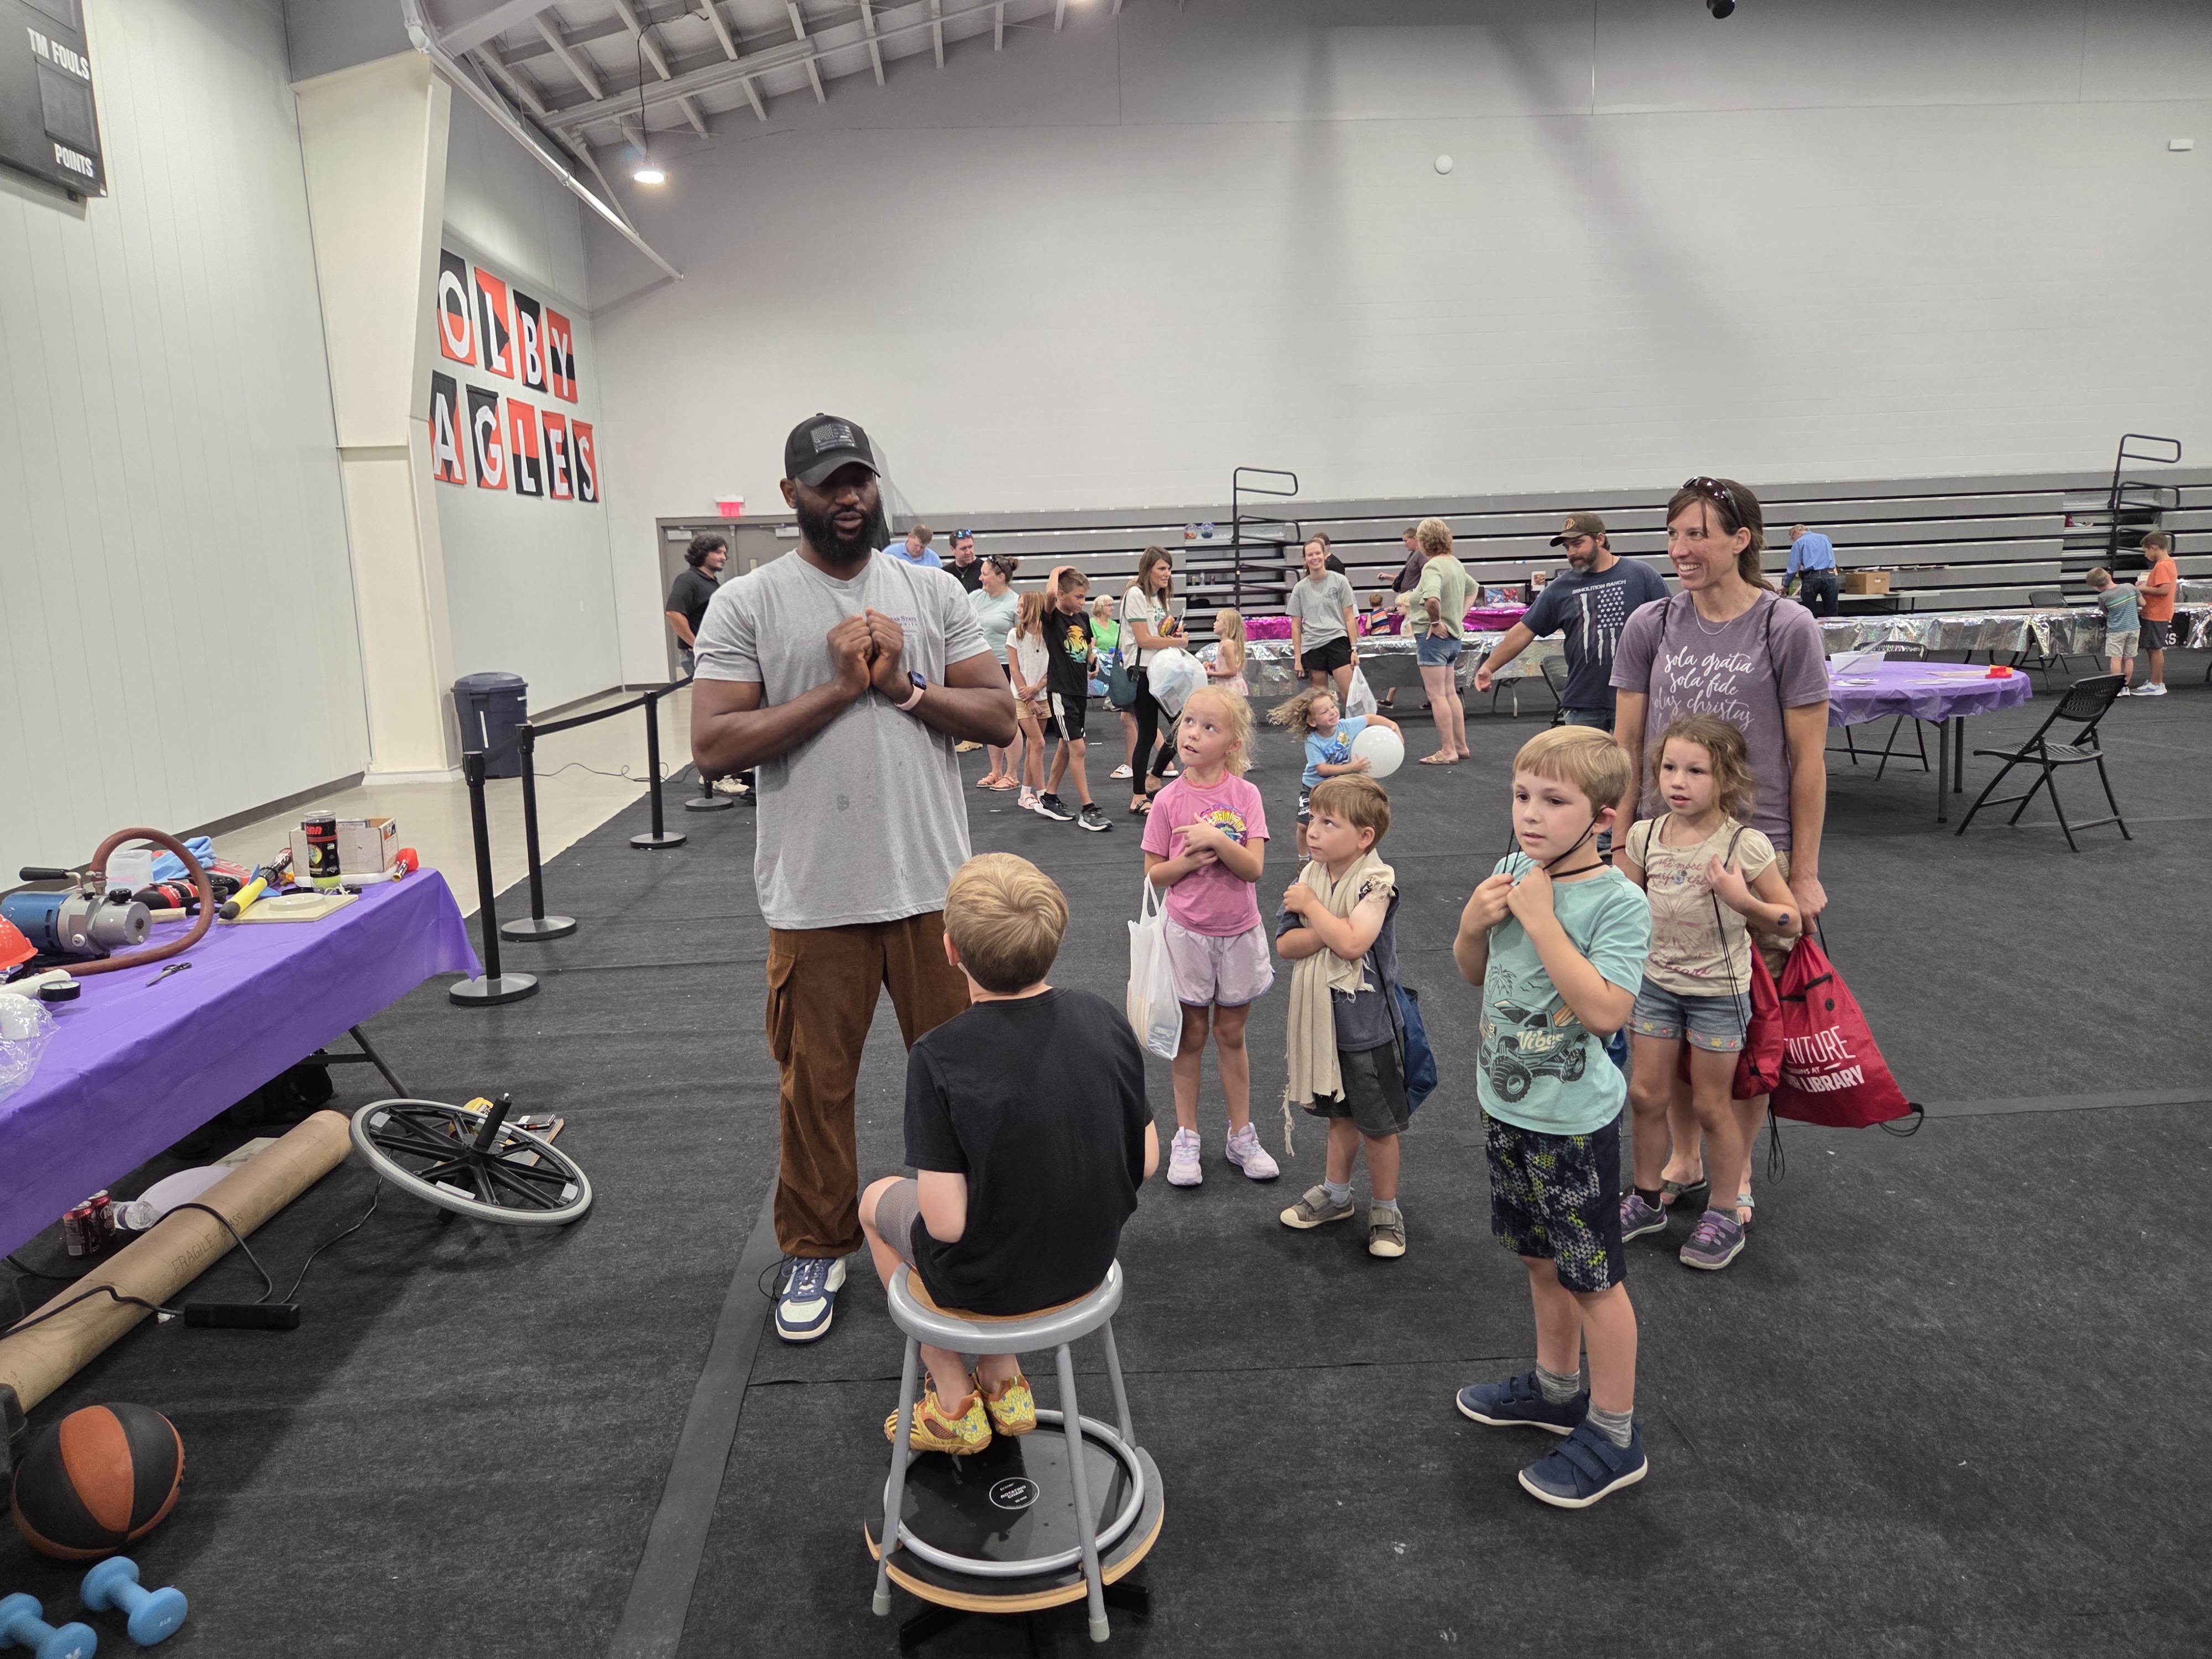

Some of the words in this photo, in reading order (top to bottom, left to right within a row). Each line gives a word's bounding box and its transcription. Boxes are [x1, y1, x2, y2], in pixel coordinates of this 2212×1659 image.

[27, 27, 50, 59] TM
[50, 40, 90, 80] FOULS
[54, 143, 95, 178] POINTS
[1572, 583, 1605, 594] DEMOLITION
[1606, 579, 1626, 588] RANCH
[1665, 645, 1698, 674] sola
[1701, 652, 1755, 676] gratia
[1670, 667, 1704, 693] sola
[1706, 672, 1739, 698] fide
[1517, 1030, 1564, 1051] Vibes
[1800, 1065, 1865, 1093] LIBRARY
